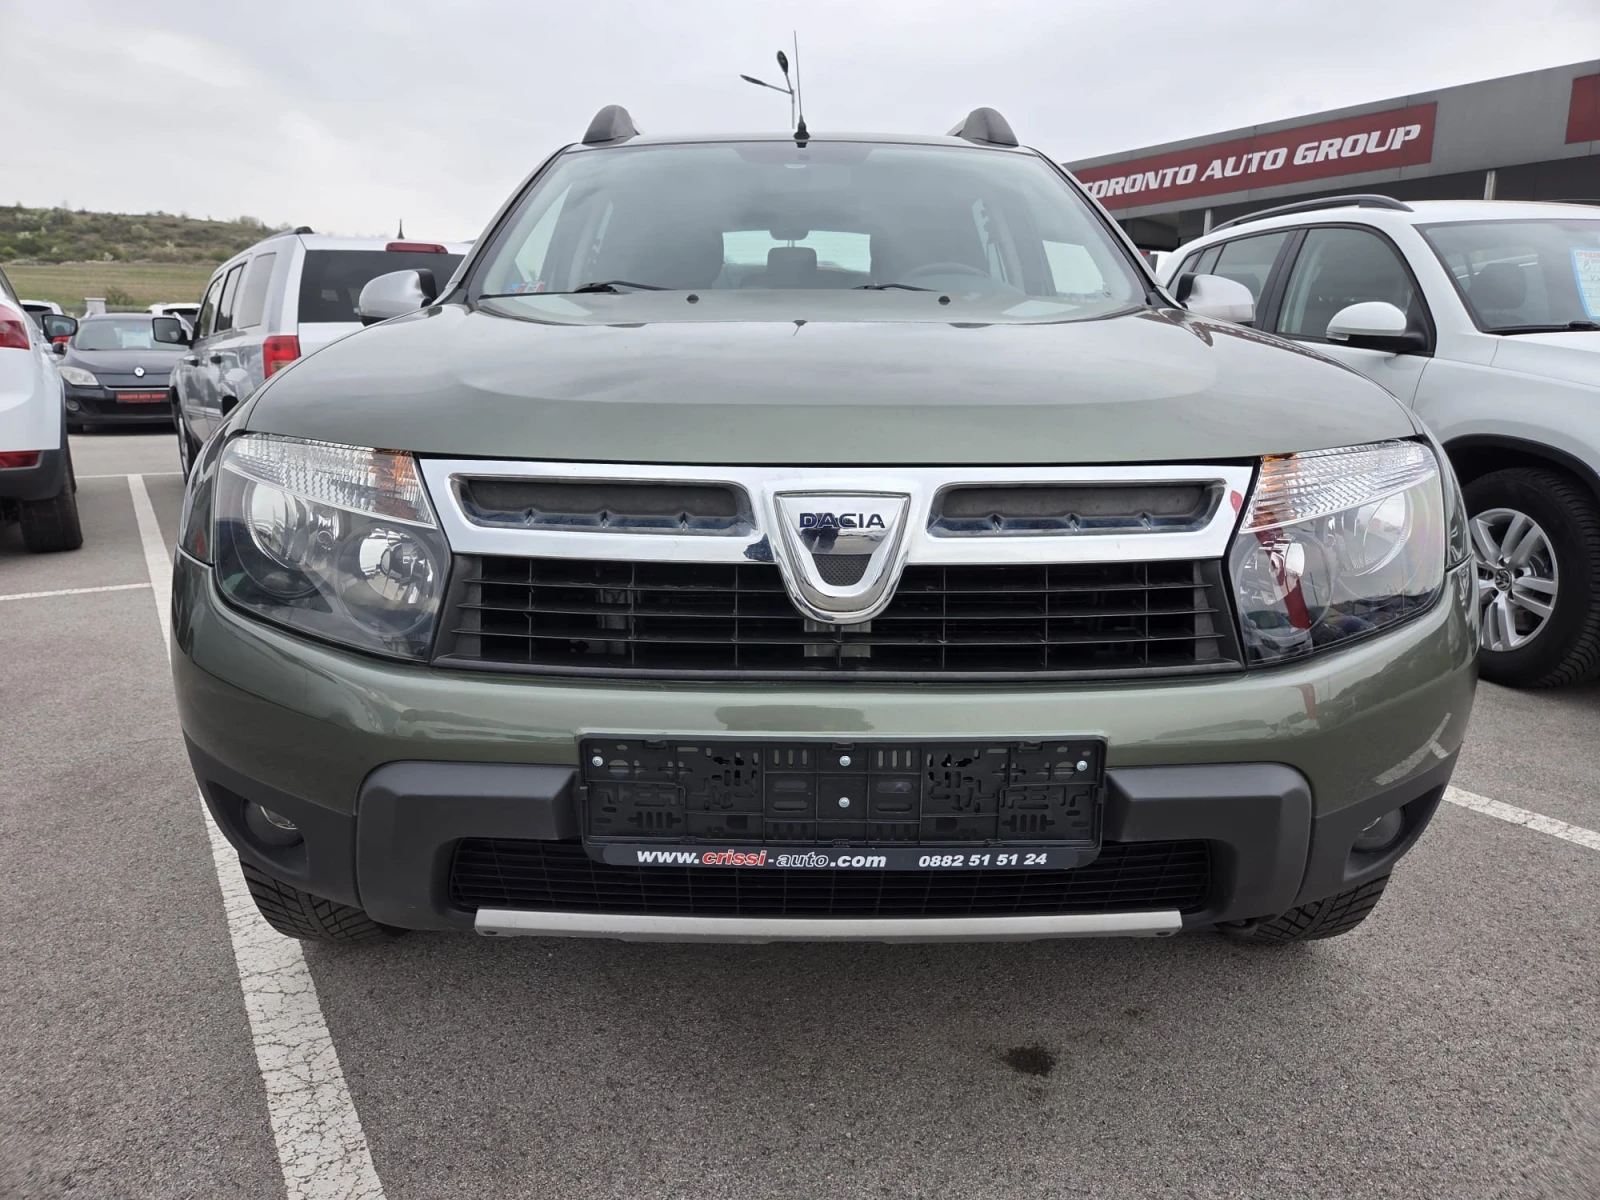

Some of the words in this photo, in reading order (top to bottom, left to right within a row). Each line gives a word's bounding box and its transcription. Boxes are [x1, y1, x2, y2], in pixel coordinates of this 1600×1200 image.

[1199, 147, 1288, 182] AUTO
[1293, 124, 1421, 166] GROUP
[799, 512, 886, 529] DACIA
[637, 849, 887, 868] www.crissi-auto.com
[918, 854, 964, 868] 0882
[968, 854, 991, 866] 51
[996, 853, 1018, 866] 51
[1023, 853, 1048, 865] 24
